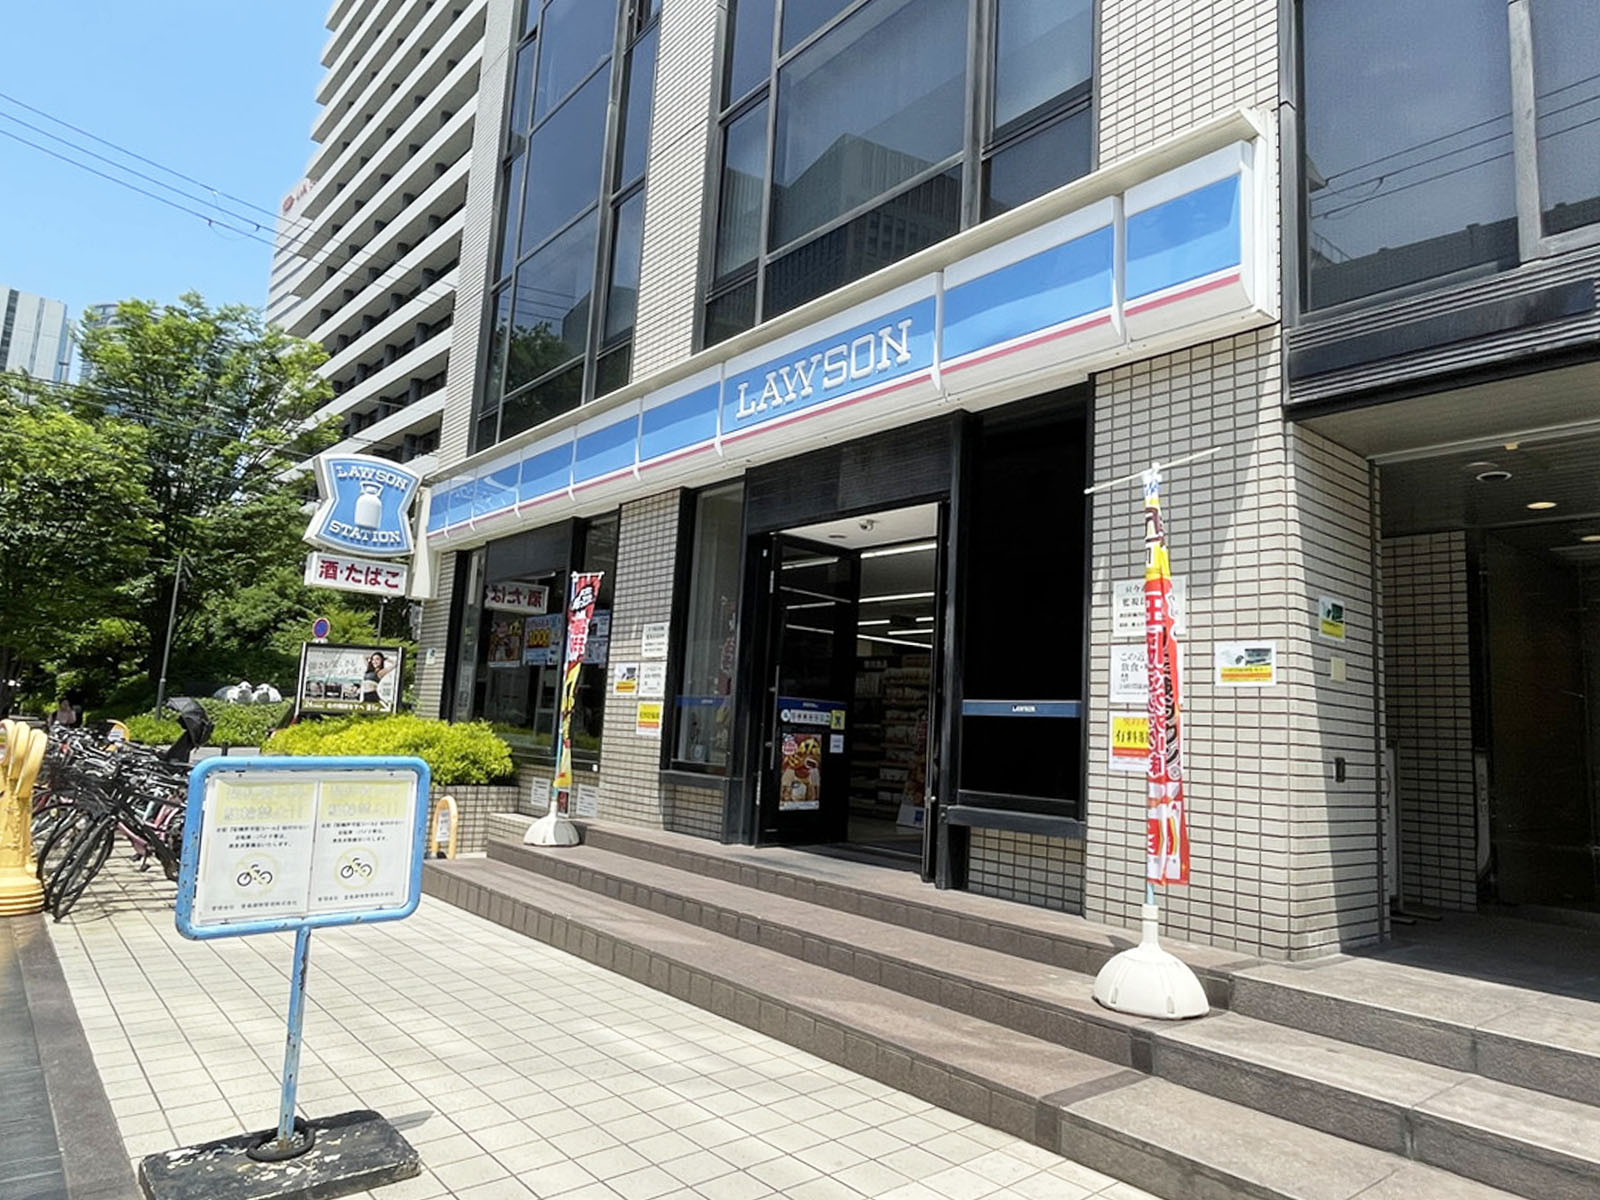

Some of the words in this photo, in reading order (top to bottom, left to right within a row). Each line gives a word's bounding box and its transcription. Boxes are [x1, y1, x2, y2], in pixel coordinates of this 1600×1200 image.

[736, 318, 912, 419] LAWSON
[335, 464, 409, 491] LAWSON
[328, 520, 401, 543] STATION
[319, 559, 400, 589] 酒・たばこ
